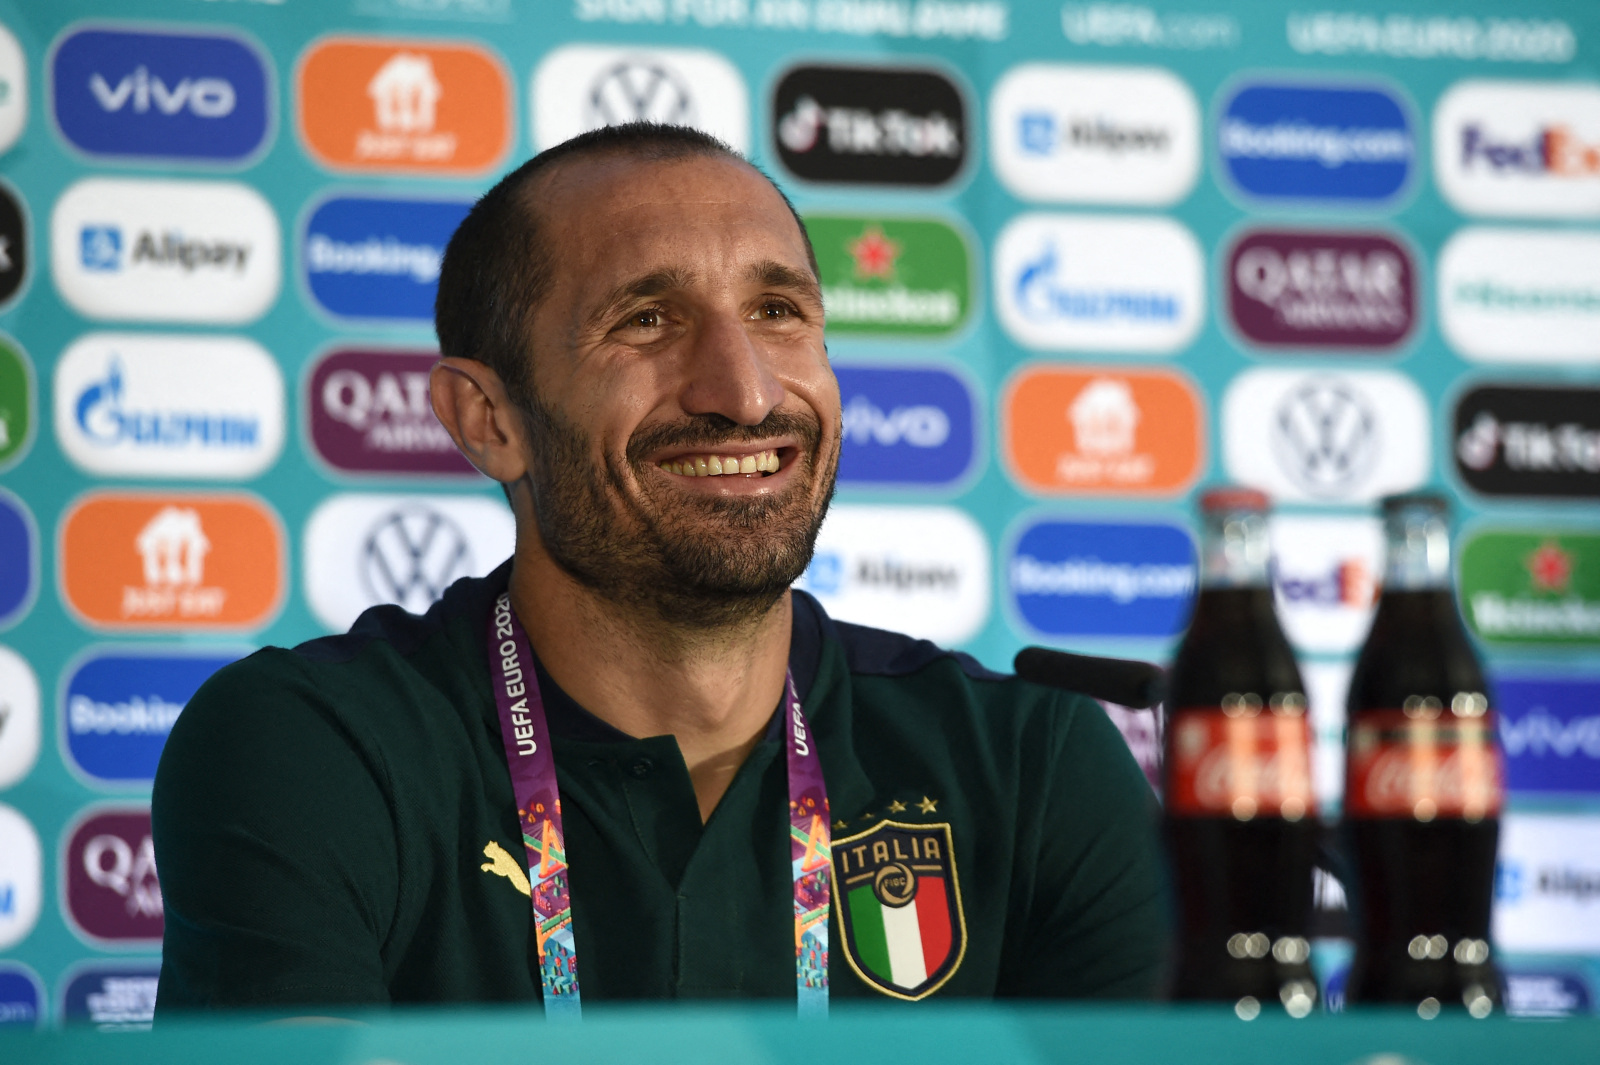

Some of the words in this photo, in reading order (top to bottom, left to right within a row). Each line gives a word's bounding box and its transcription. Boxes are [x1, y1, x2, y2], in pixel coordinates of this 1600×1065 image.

[1287, 12, 1377, 54] UEFA
[1382, 15, 1481, 59] EURO
[1485, 18, 1576, 62] 2020
[90, 66, 235, 117] vivo
[823, 107, 959, 155] TikTok
[1066, 118, 1170, 154] Alipay
[1221, 117, 1408, 168] Booking.com
[132, 229, 249, 275] Alipay
[308, 236, 437, 283] Booking
[1236, 247, 1405, 304] QATAR
[823, 284, 959, 325] eineken
[1276, 302, 1407, 330] AIRWAYS
[322, 370, 431, 430] QAT
[366, 424, 451, 452] AIRW
[1501, 424, 1600, 471] TikTo
[853, 557, 959, 594] Alipay
[121, 586, 176, 618] JUST
[499, 640, 526, 698] EURO
[70, 693, 183, 736] Bookin
[510, 697, 537, 756] UEFA
[792, 702, 809, 756] UEFA
[842, 837, 940, 874] ITALIA
[1537, 865, 1600, 905] Alip
